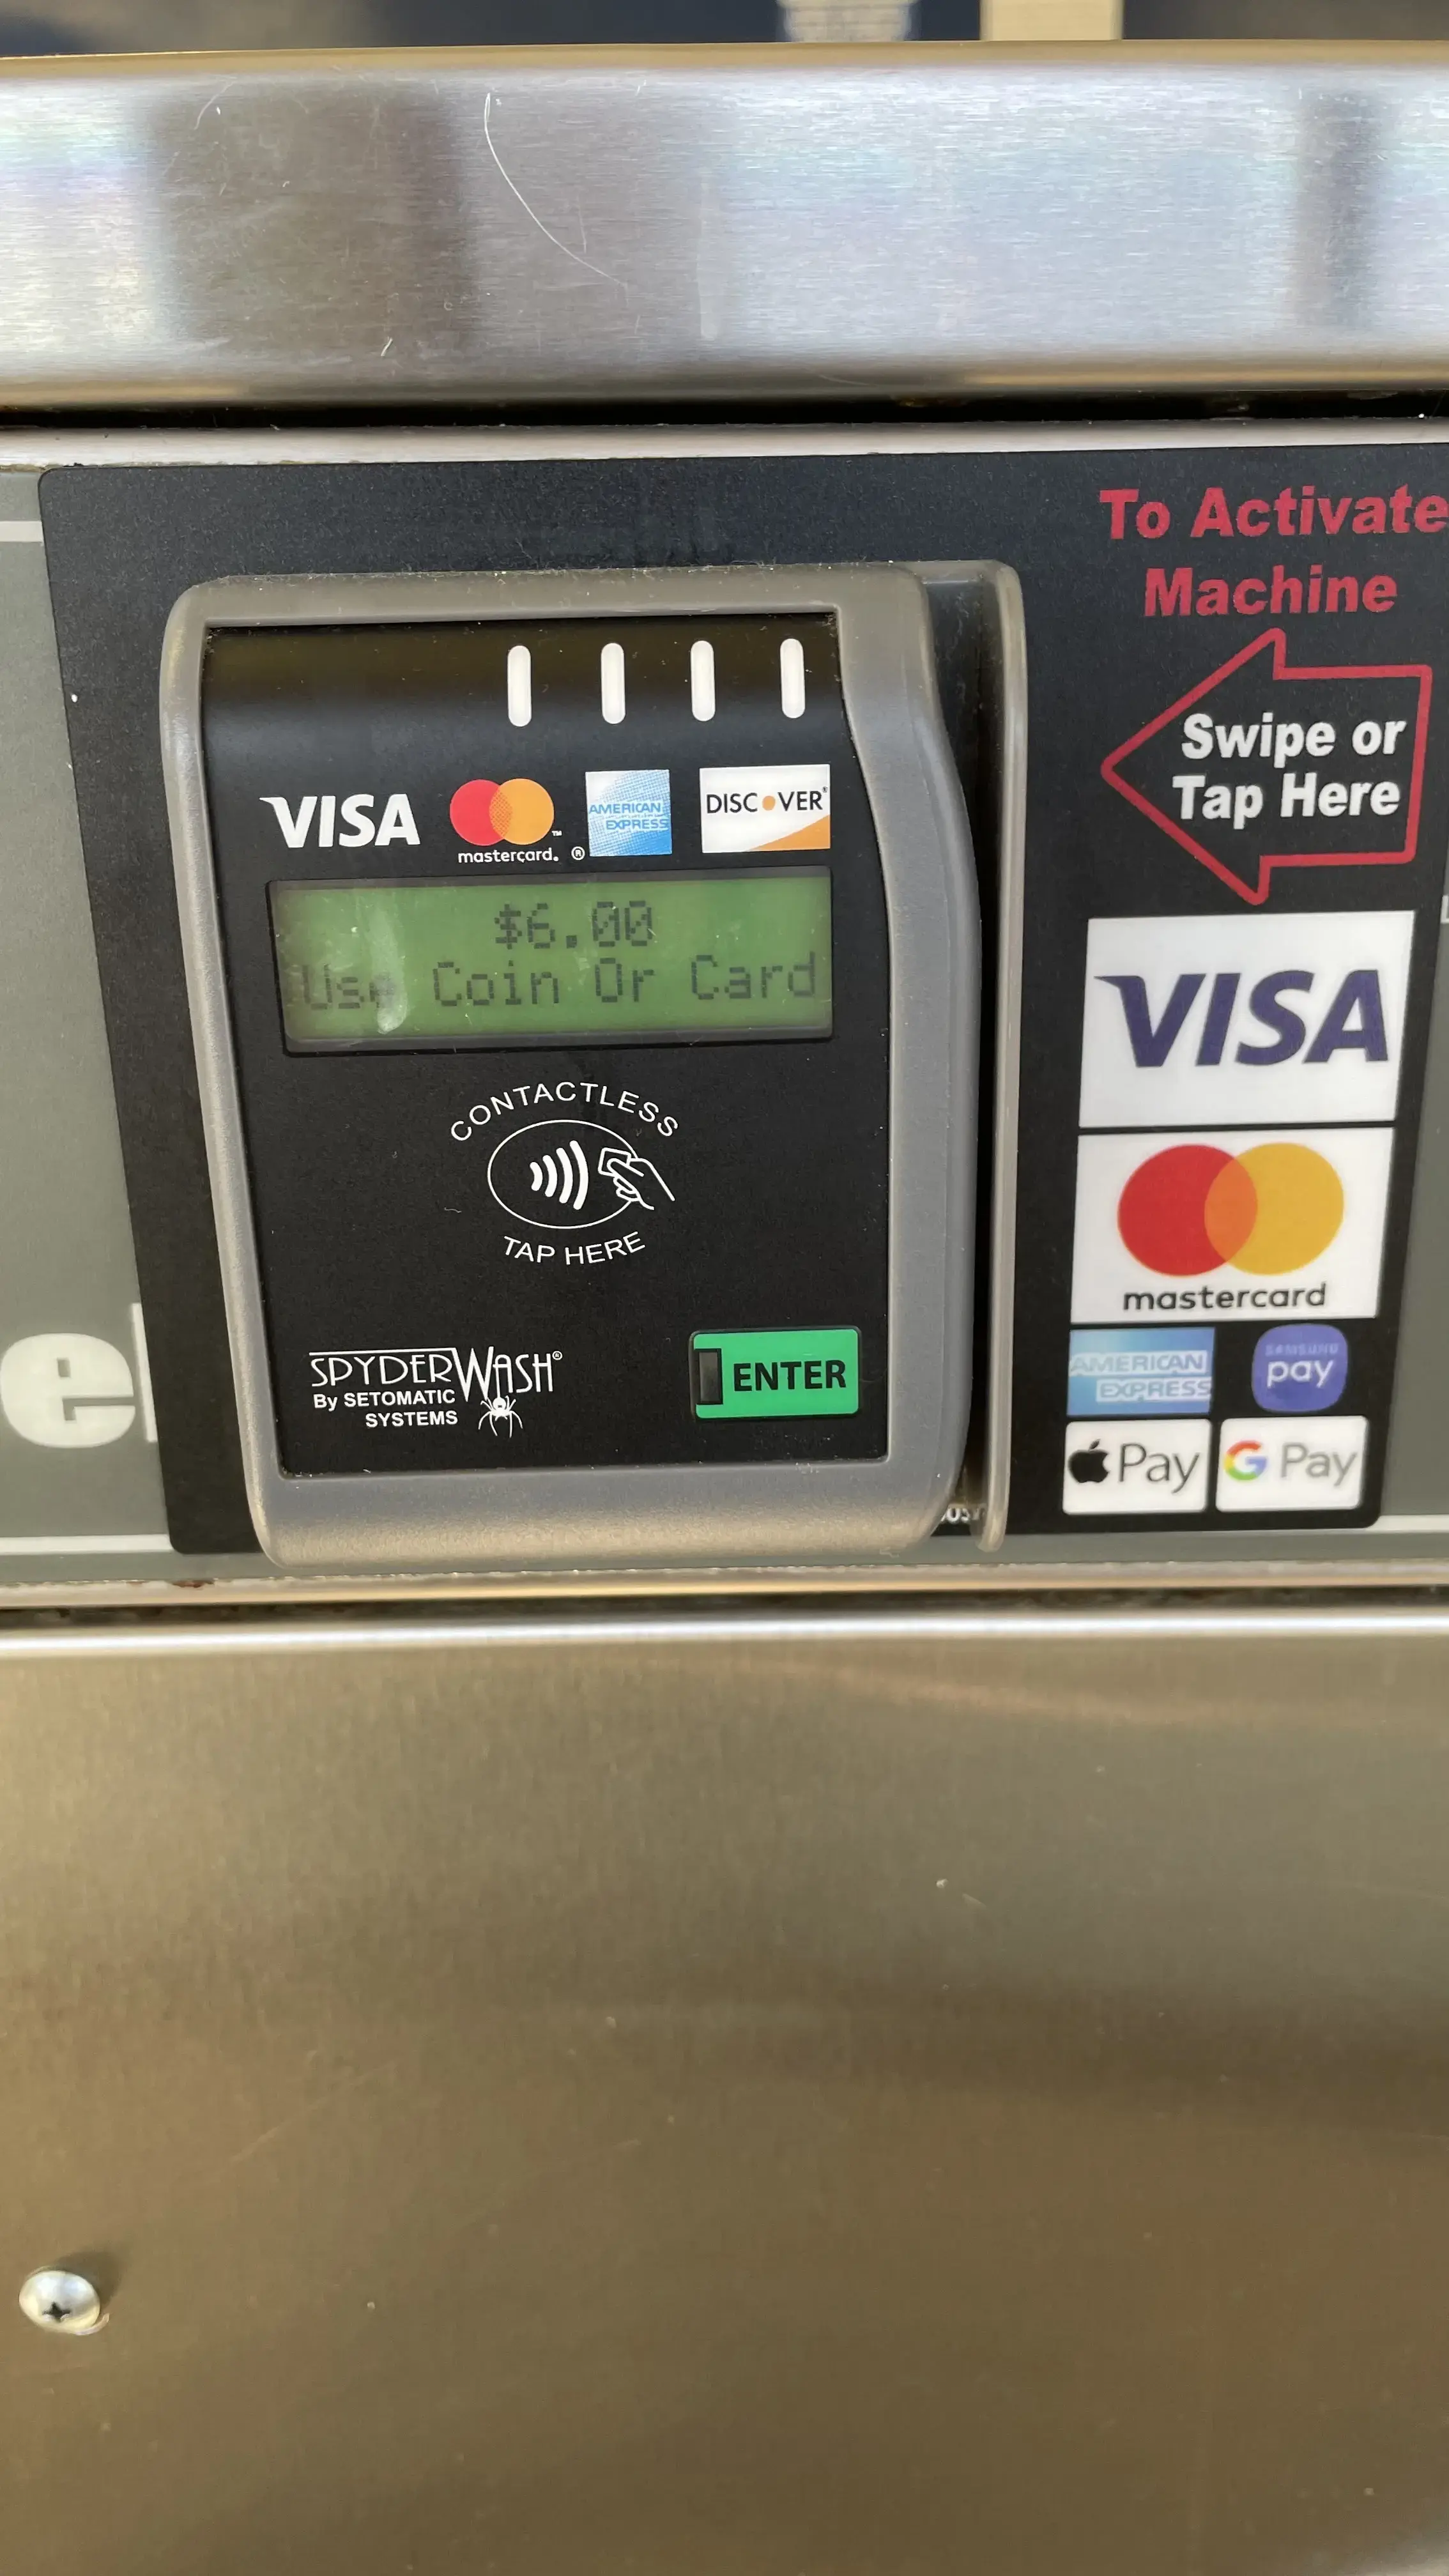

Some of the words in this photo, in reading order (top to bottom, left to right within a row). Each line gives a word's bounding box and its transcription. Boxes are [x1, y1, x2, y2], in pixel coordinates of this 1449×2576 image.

[1099, 489, 1171, 540] To
[1190, 484, 1449, 538] Activate
[1144, 564, 1398, 617] Machine
[1181, 712, 1337, 769] Swipe
[1351, 720, 1407, 755] or
[259, 793, 420, 848] VISA
[588, 803, 662, 815] AMERICAN
[1172, 774, 1264, 829] Tap
[1280, 772, 1401, 817] Here
[606, 818, 670, 831] EXPRESS
[495, 900, 654, 949] $6.00
[433, 962, 560, 1007] Coin
[594, 957, 654, 1003] Or
[690, 951, 816, 999] Card
[1093, 969, 1388, 1068] VISA
[450, 1082, 678, 1141] CONTACTLESS
[503, 1236, 555, 1263] TAP
[565, 1231, 645, 1265] HERE
[1123, 1282, 1326, 1310] mastercard
[733, 1359, 847, 1393] ENTER
[1069, 1353, 1204, 1372] AMERICAN
[1266, 1359, 1335, 1388] pay
[313, 1393, 338, 1411] By
[344, 1389, 456, 1407] SETOMATIC
[1099, 1379, 1211, 1399] EXPRESS
[365, 1410, 459, 1428] SYSTEMS
[1118, 1443, 1200, 1494] Pay
[1280, 1441, 1357, 1487] Pay
